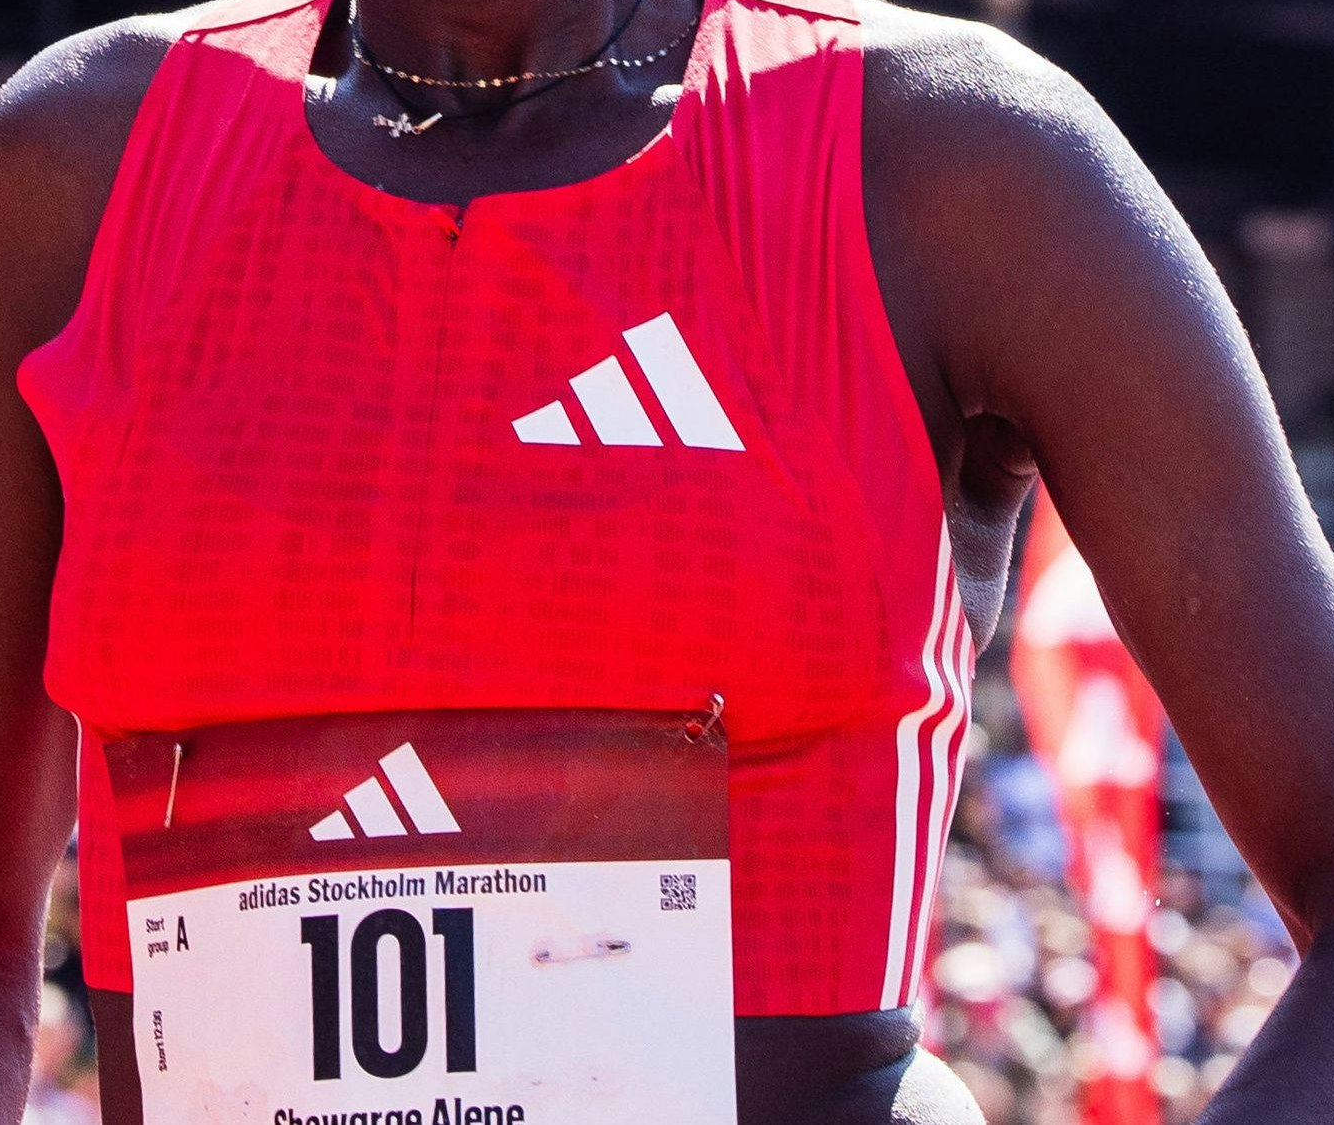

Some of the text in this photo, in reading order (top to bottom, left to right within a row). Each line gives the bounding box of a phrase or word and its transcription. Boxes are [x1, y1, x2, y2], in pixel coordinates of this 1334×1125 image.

[239, 869, 547, 911] adidas Stockholm Marathon
[147, 940, 169, 958] group
[176, 915, 190, 952] A
[300, 906, 478, 1081] 101
